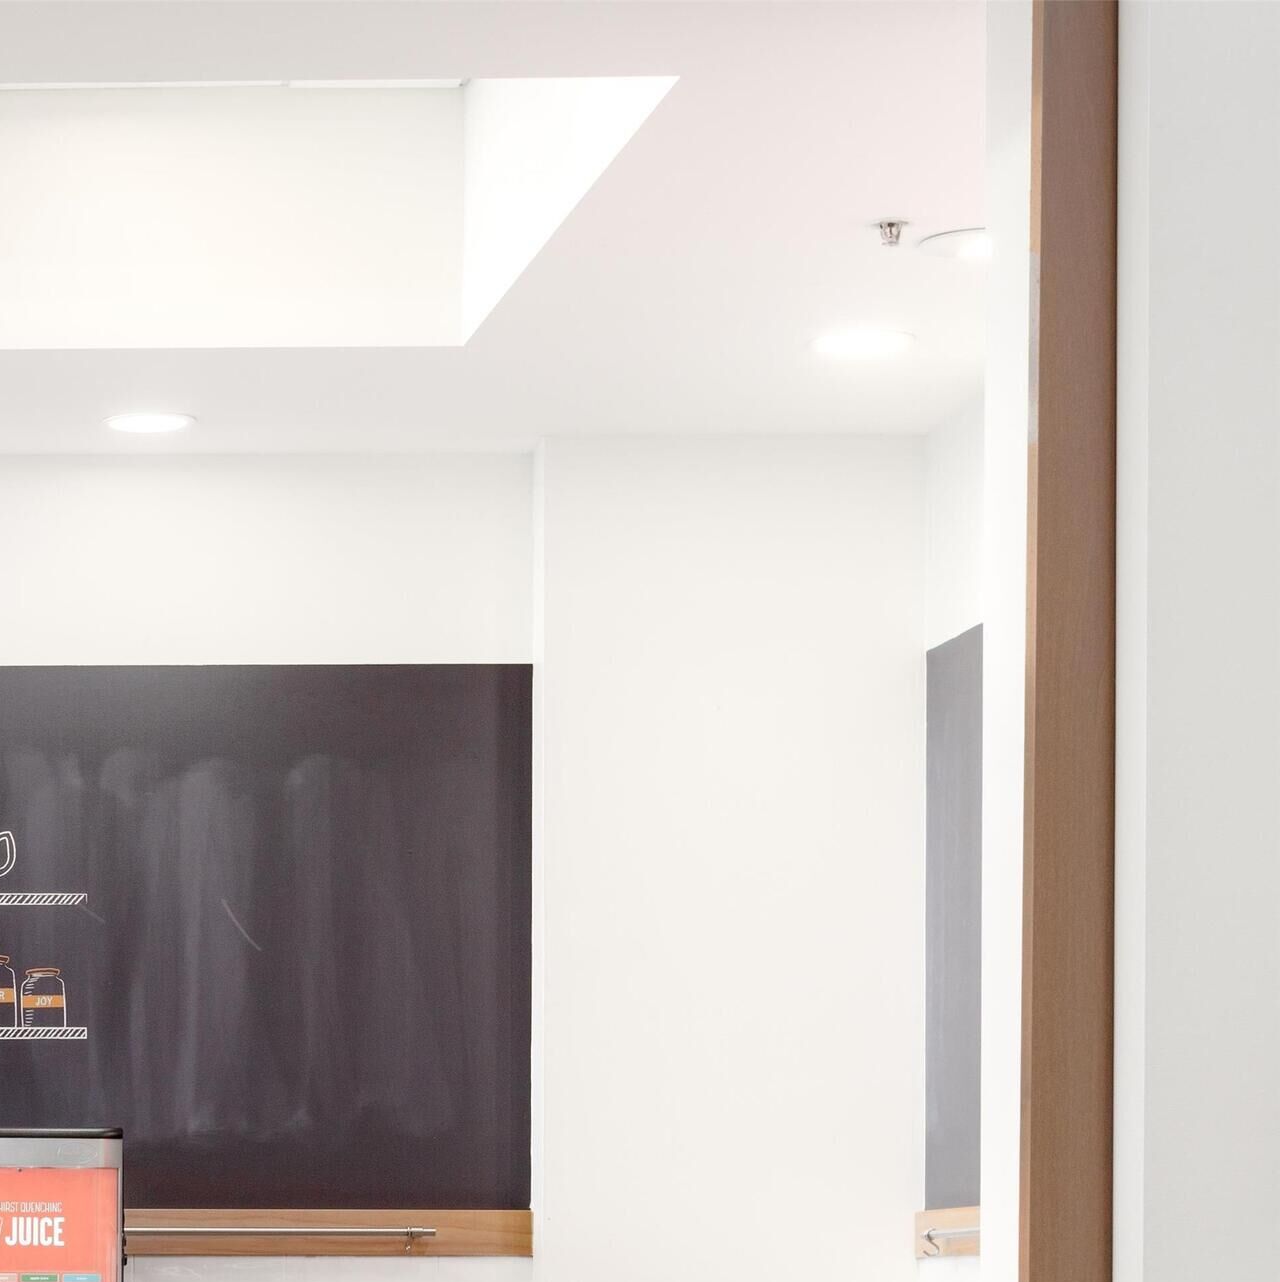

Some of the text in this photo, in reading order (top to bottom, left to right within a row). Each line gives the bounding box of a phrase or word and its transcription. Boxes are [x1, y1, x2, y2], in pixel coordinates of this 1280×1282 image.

[34, 996, 53, 1007] JOY
[20, 1201, 63, 1213] QUENCHING
[4, 1216, 65, 1247] JUICE
